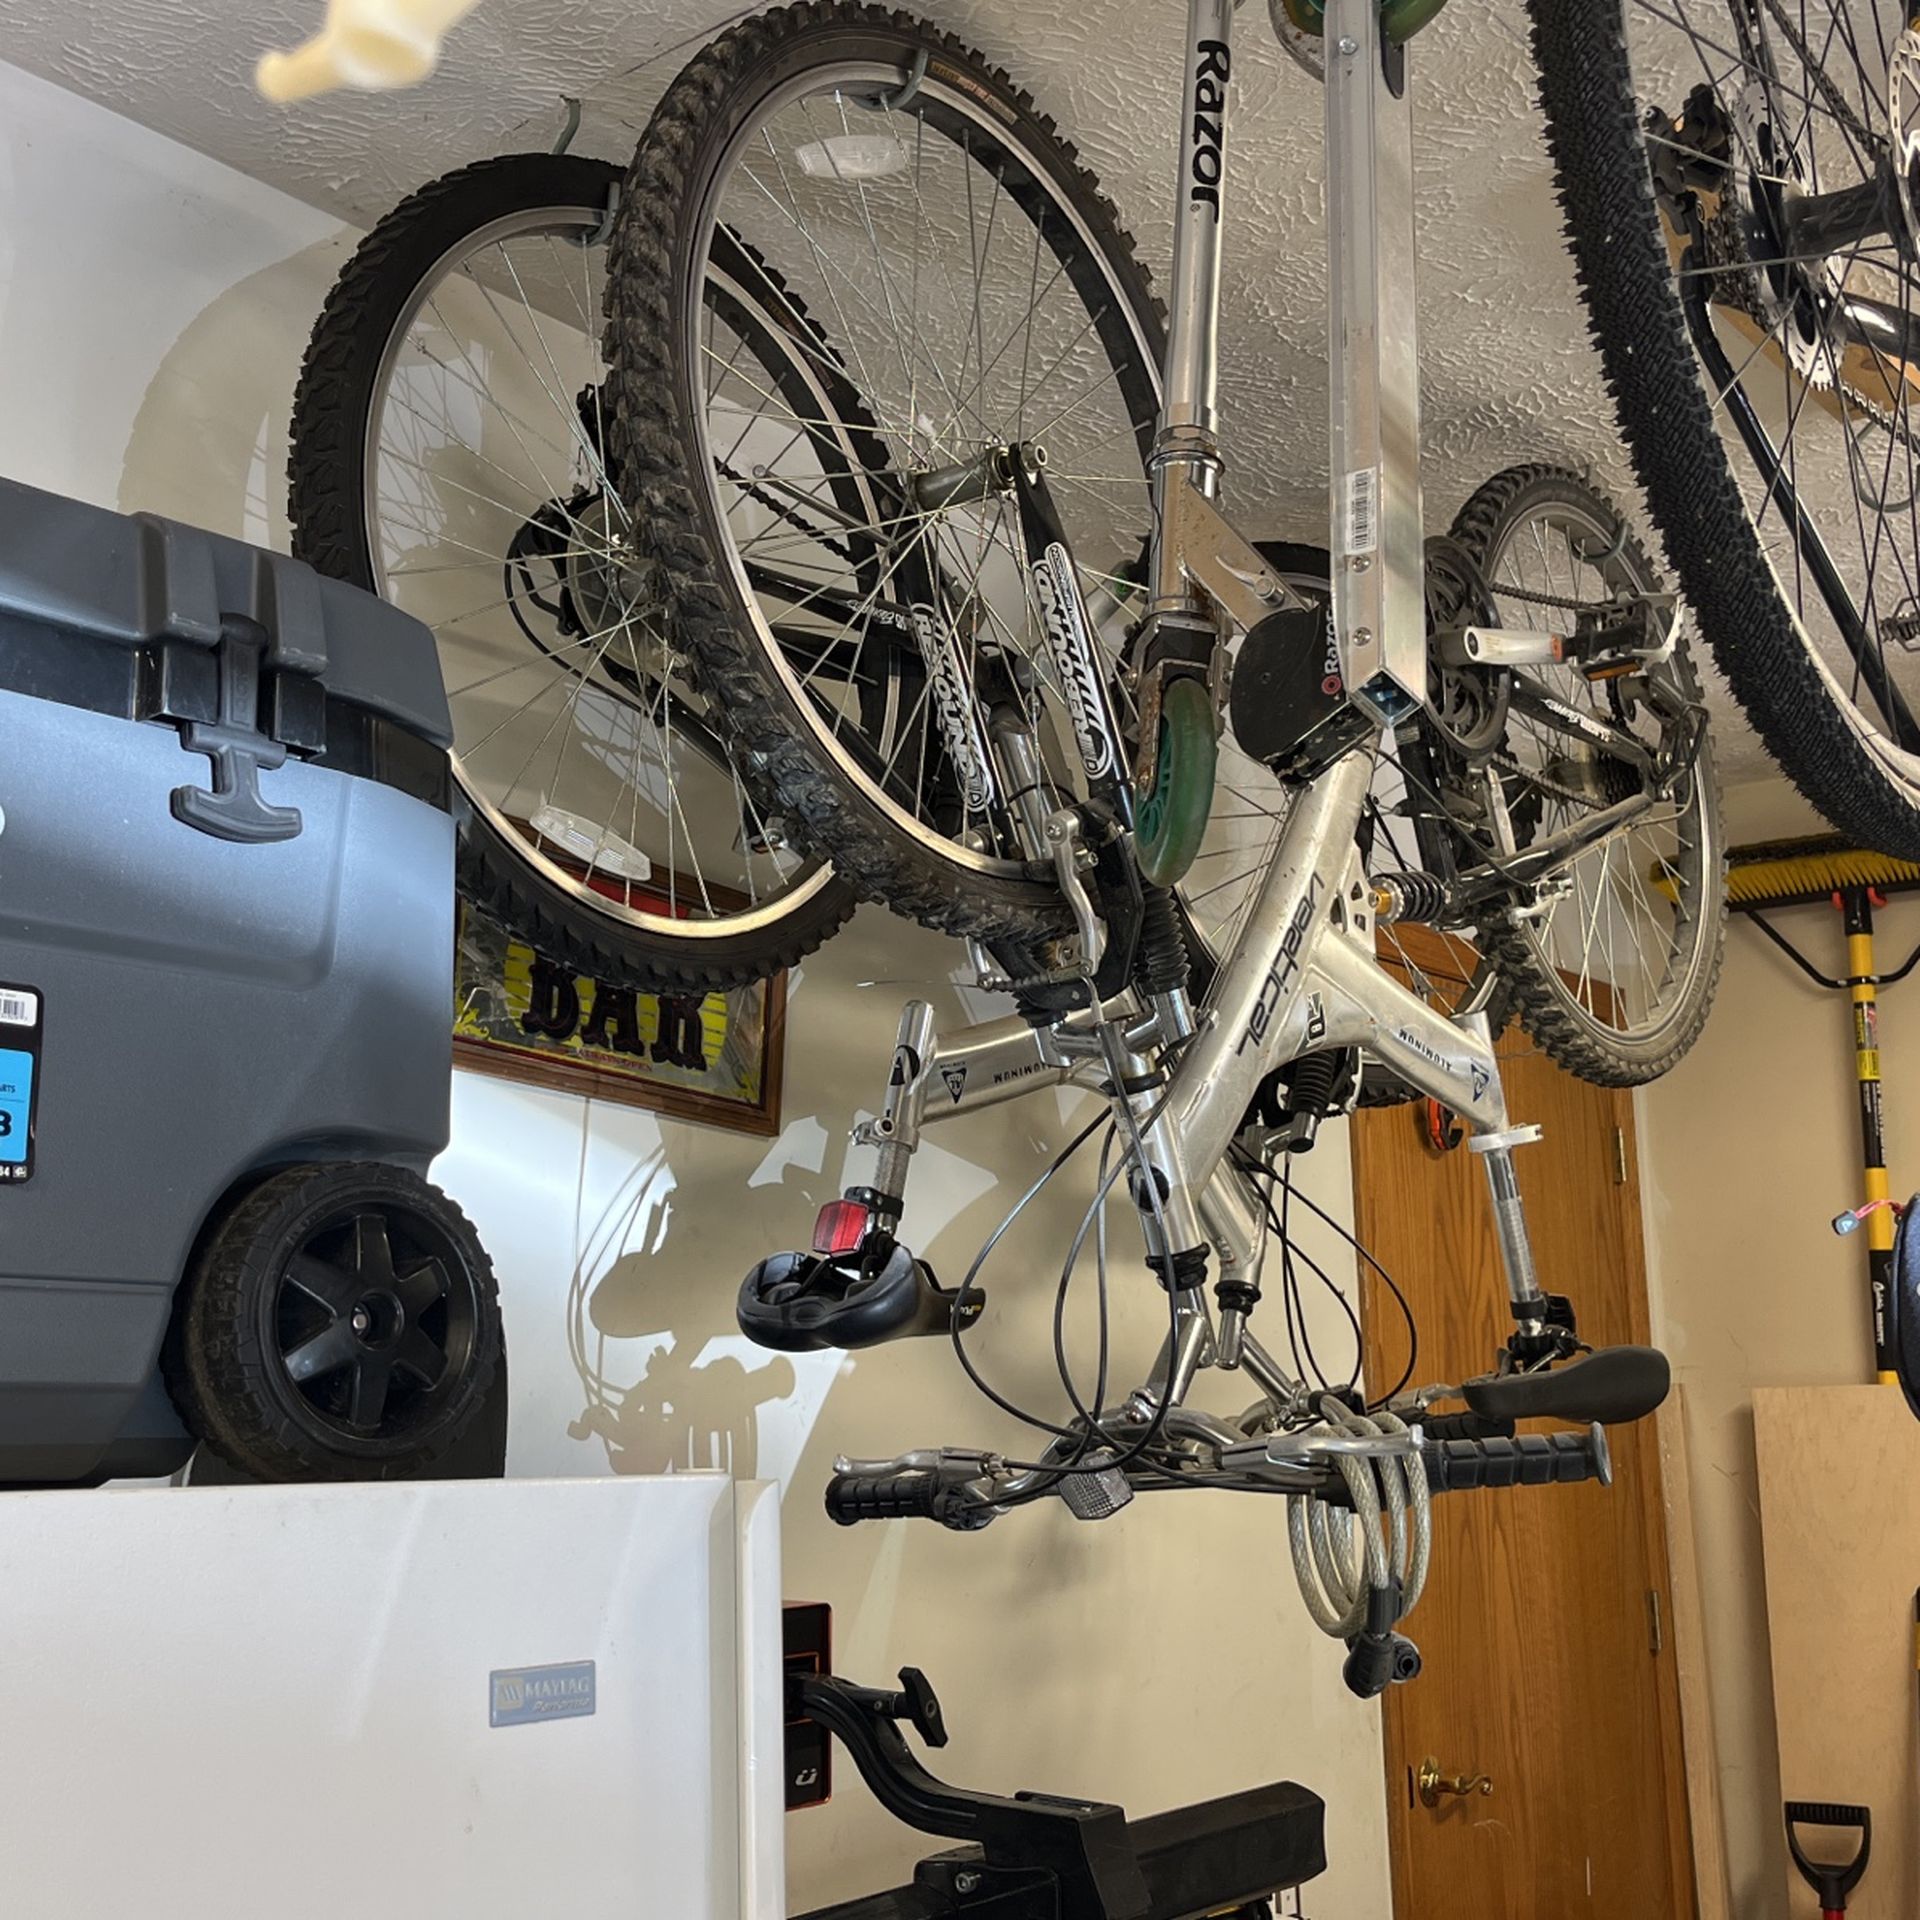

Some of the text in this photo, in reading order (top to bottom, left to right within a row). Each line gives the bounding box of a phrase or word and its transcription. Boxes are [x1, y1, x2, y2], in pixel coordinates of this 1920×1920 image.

[1192, 39, 1231, 224] Razor
[1033, 564, 1088, 741] REBOUND
[1399, 1028, 1452, 1072] ALUMINUM
[525, 1676, 590, 1697] MAYTAG
